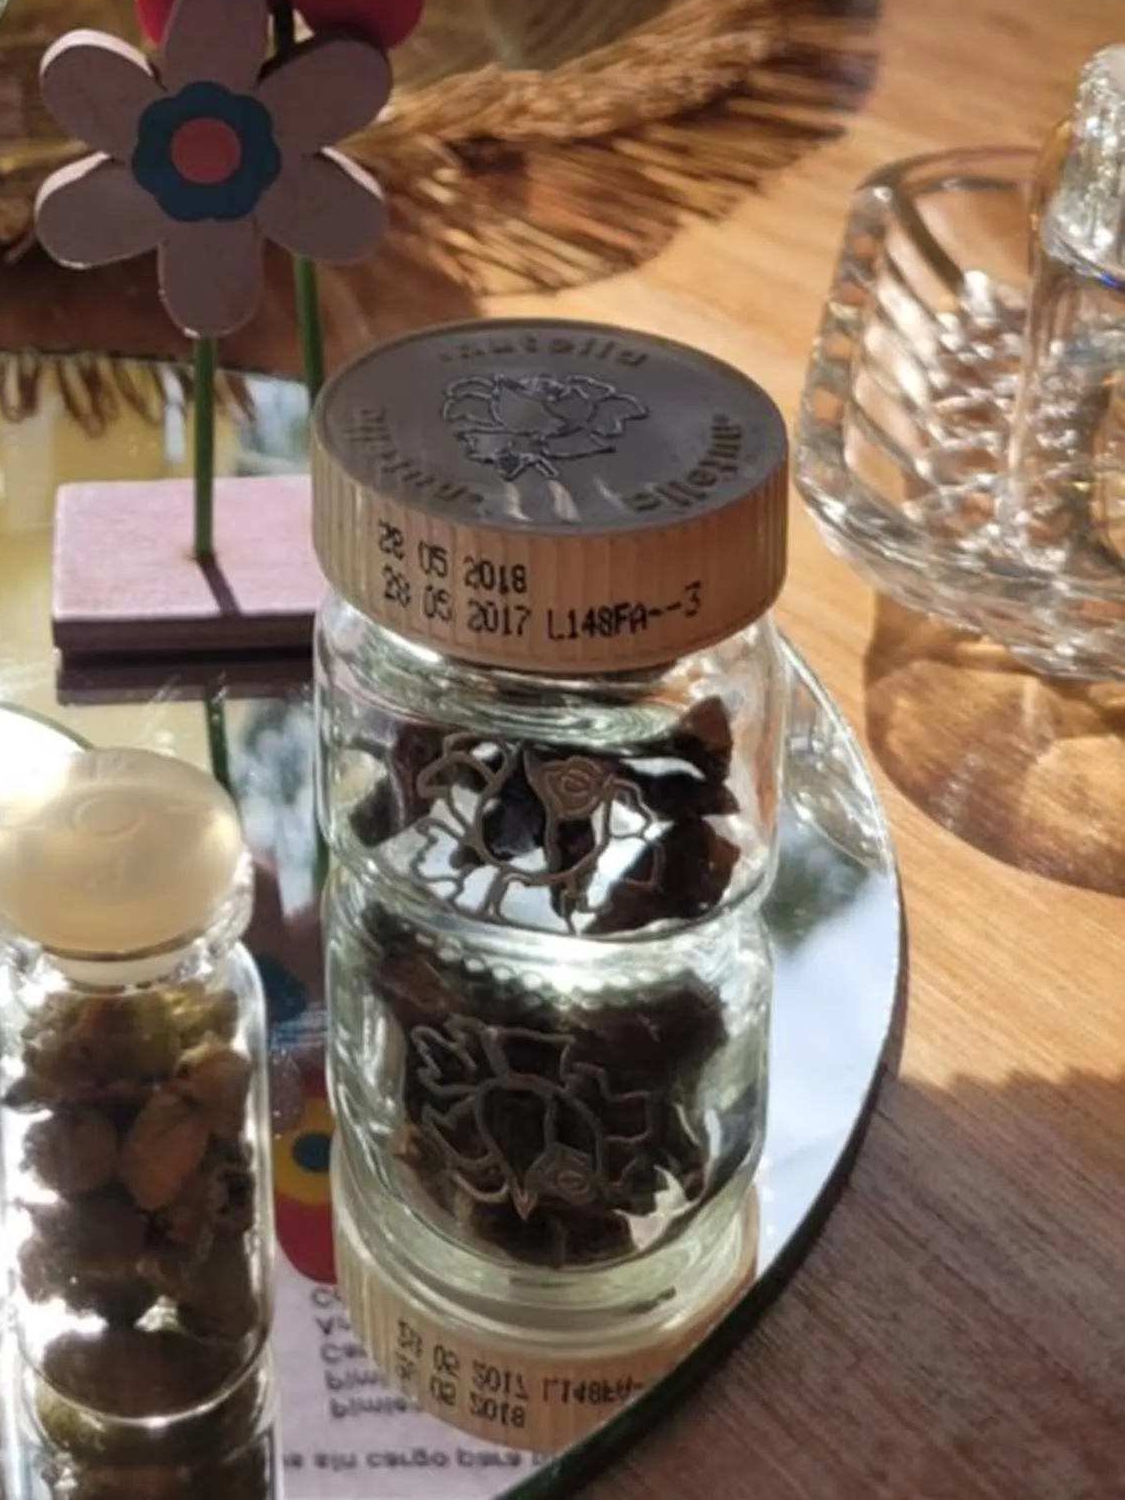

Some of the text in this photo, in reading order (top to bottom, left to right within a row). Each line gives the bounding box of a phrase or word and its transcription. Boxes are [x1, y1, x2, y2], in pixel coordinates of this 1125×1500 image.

[418, 540, 448, 579] 05
[463, 556, 529, 595] 2018
[424, 585, 452, 622] 05
[467, 600, 532, 637] 2017
